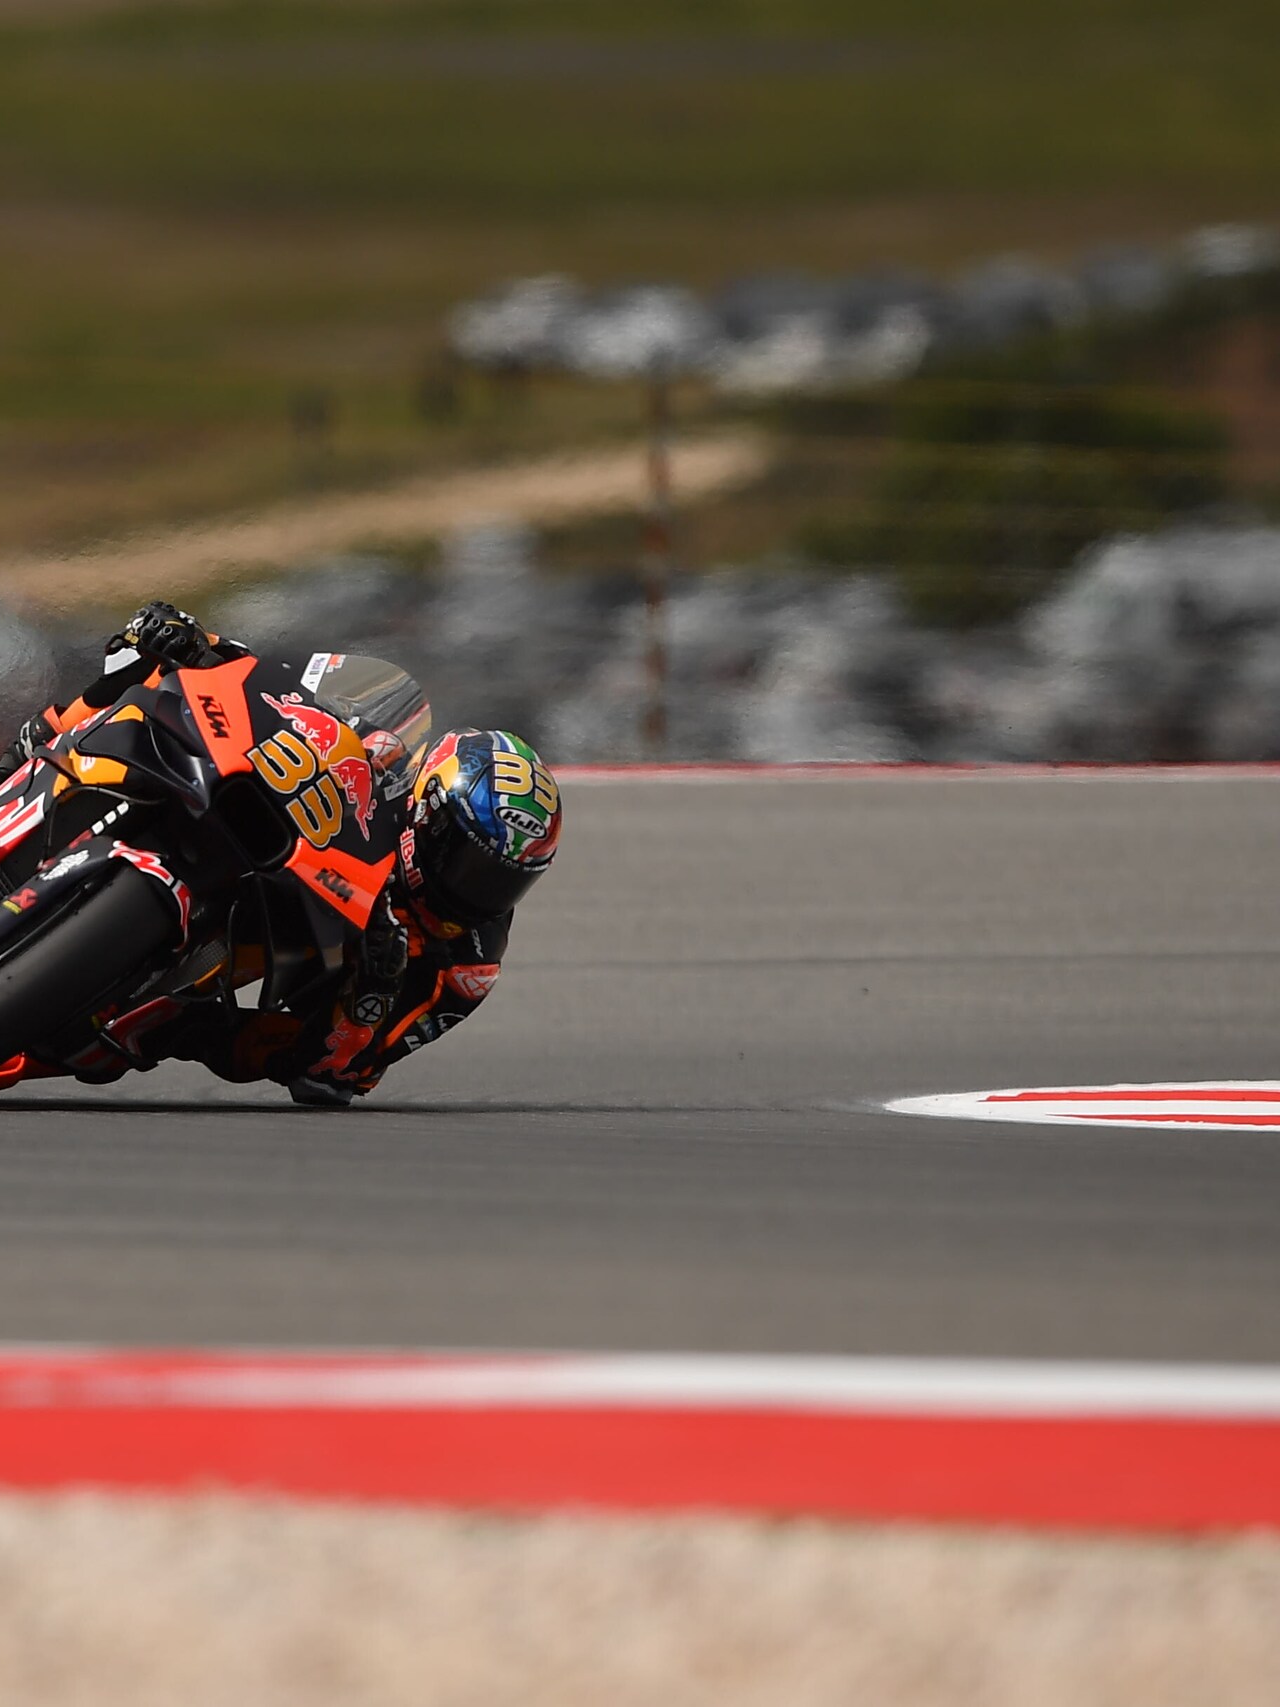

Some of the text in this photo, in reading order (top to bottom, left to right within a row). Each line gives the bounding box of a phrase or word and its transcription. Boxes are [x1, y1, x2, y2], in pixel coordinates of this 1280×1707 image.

[197, 694, 231, 739] KTM
[246, 729, 344, 849] 33
[492, 751, 559, 814] 33
[502, 811, 544, 836] HJC
[315, 867, 353, 904] KTM
